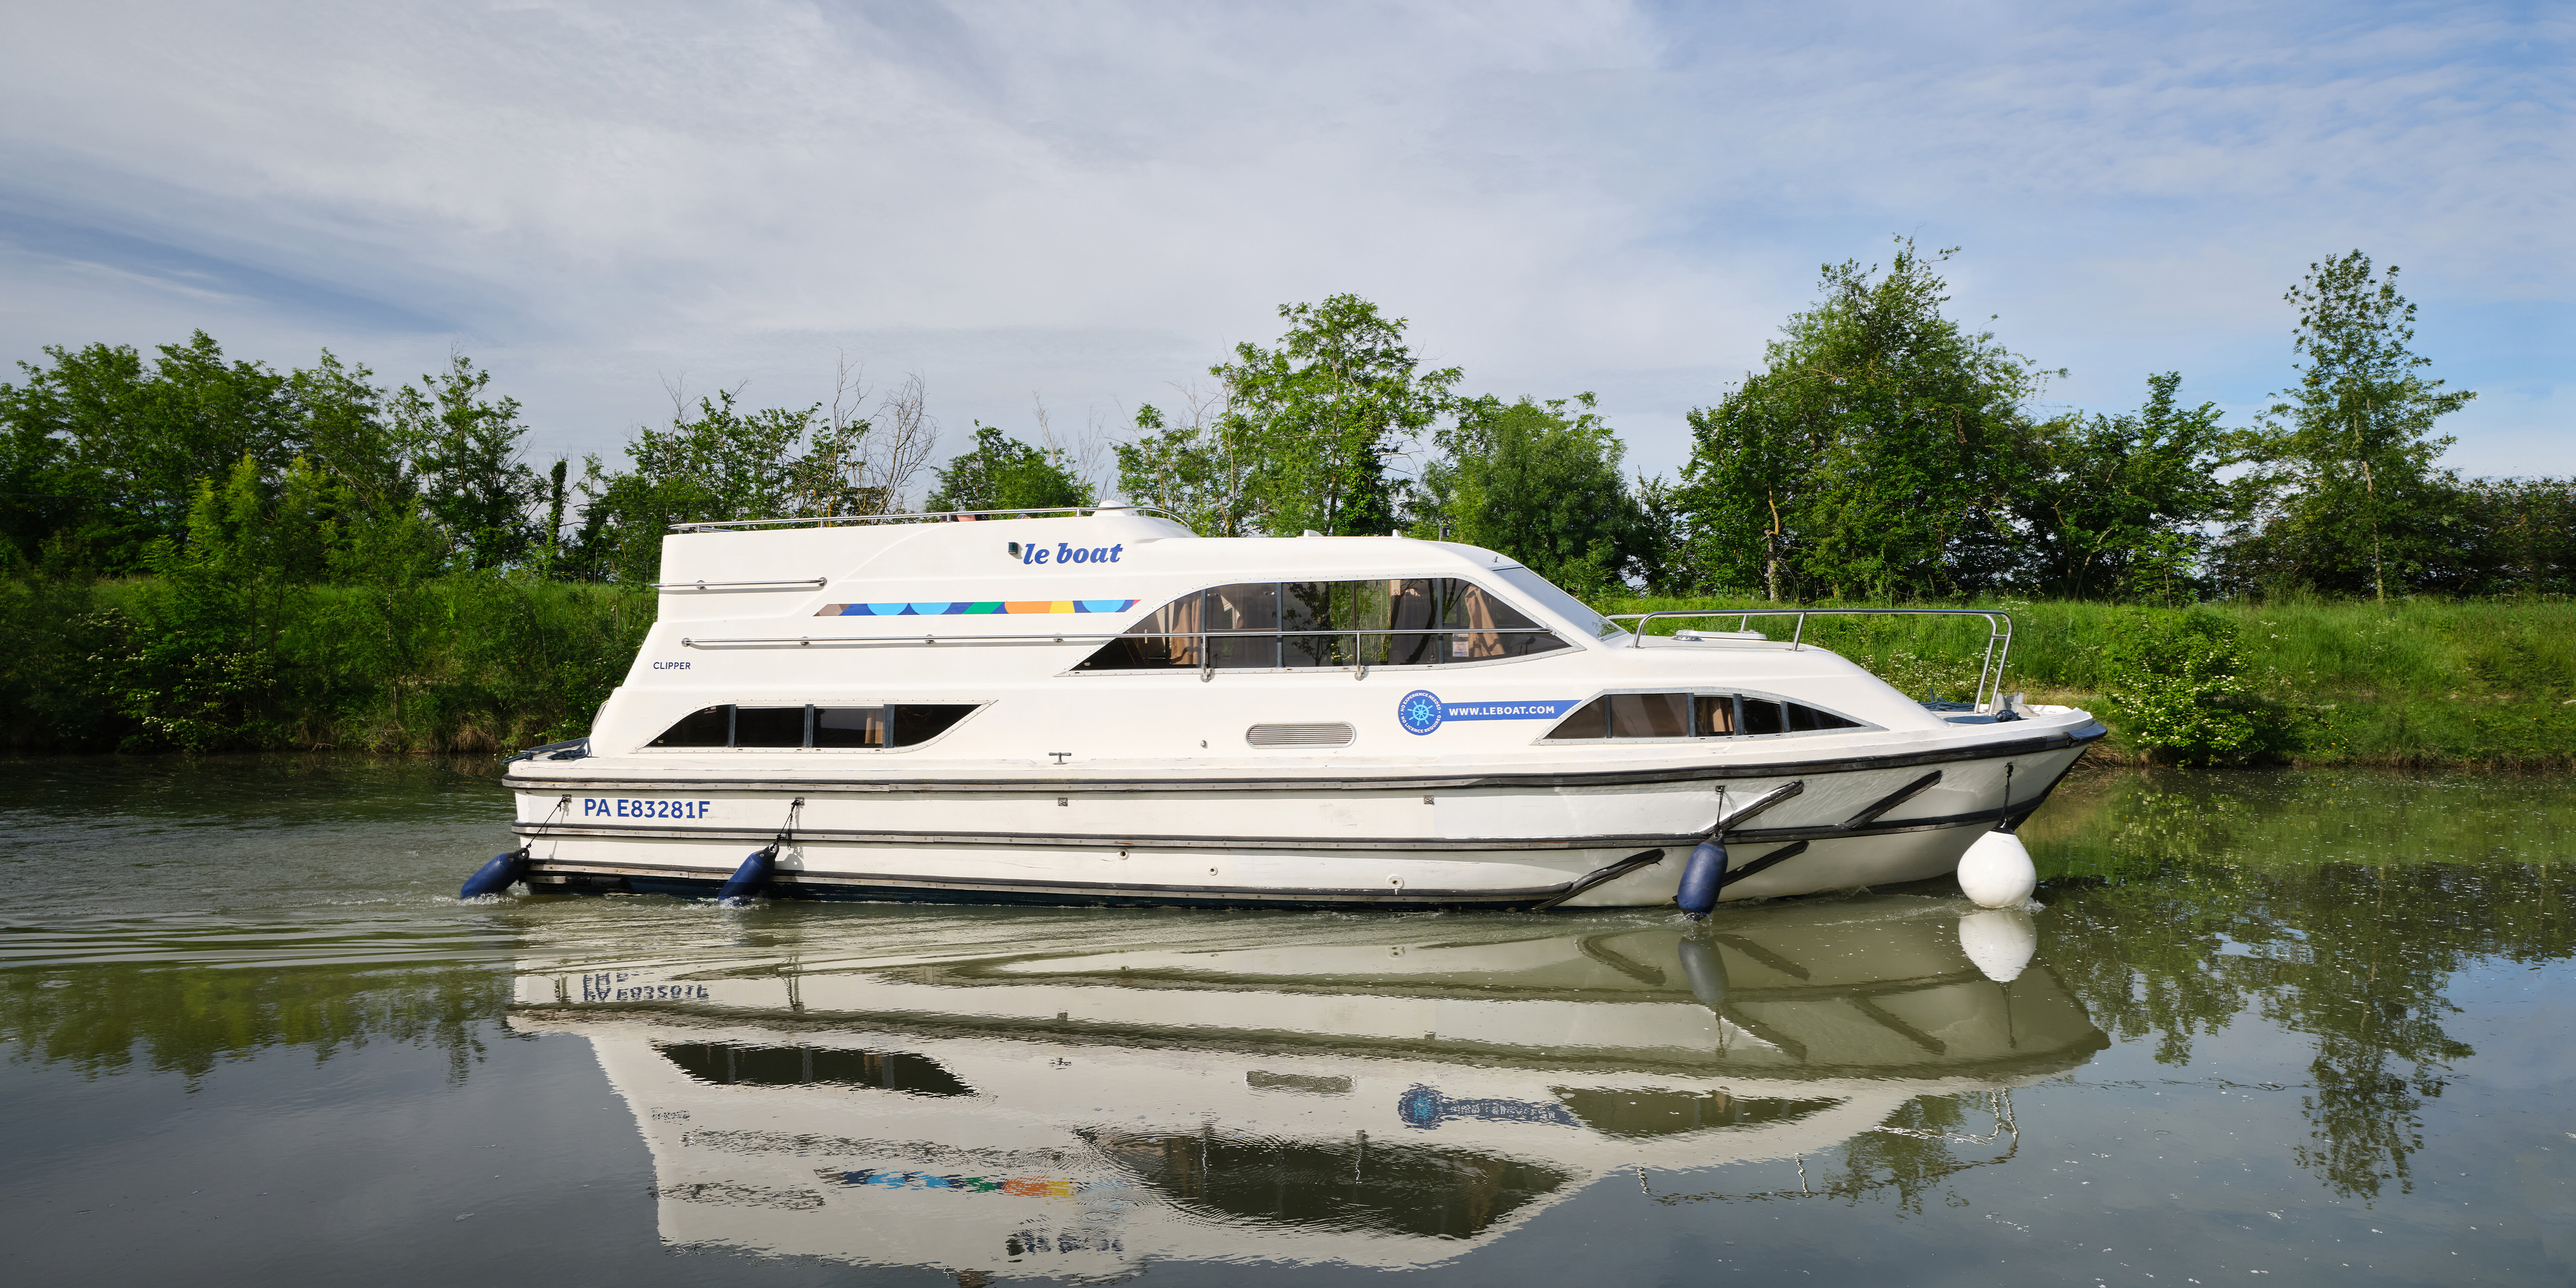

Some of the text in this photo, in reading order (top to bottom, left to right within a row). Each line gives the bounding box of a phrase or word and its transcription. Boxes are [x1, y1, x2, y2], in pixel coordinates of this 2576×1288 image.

[1023, 543, 1123, 564] le boat
[1403, 692, 1429, 705] EXPERIENCE
[1428, 695, 1441, 710] NEEDED
[1449, 706, 1555, 716] WWW.LEBOAT.COM
[1405, 723, 1424, 733] LICENCE
[1424, 715, 1441, 733] REQUIRED
[585, 799, 710, 818] PA E83281F
